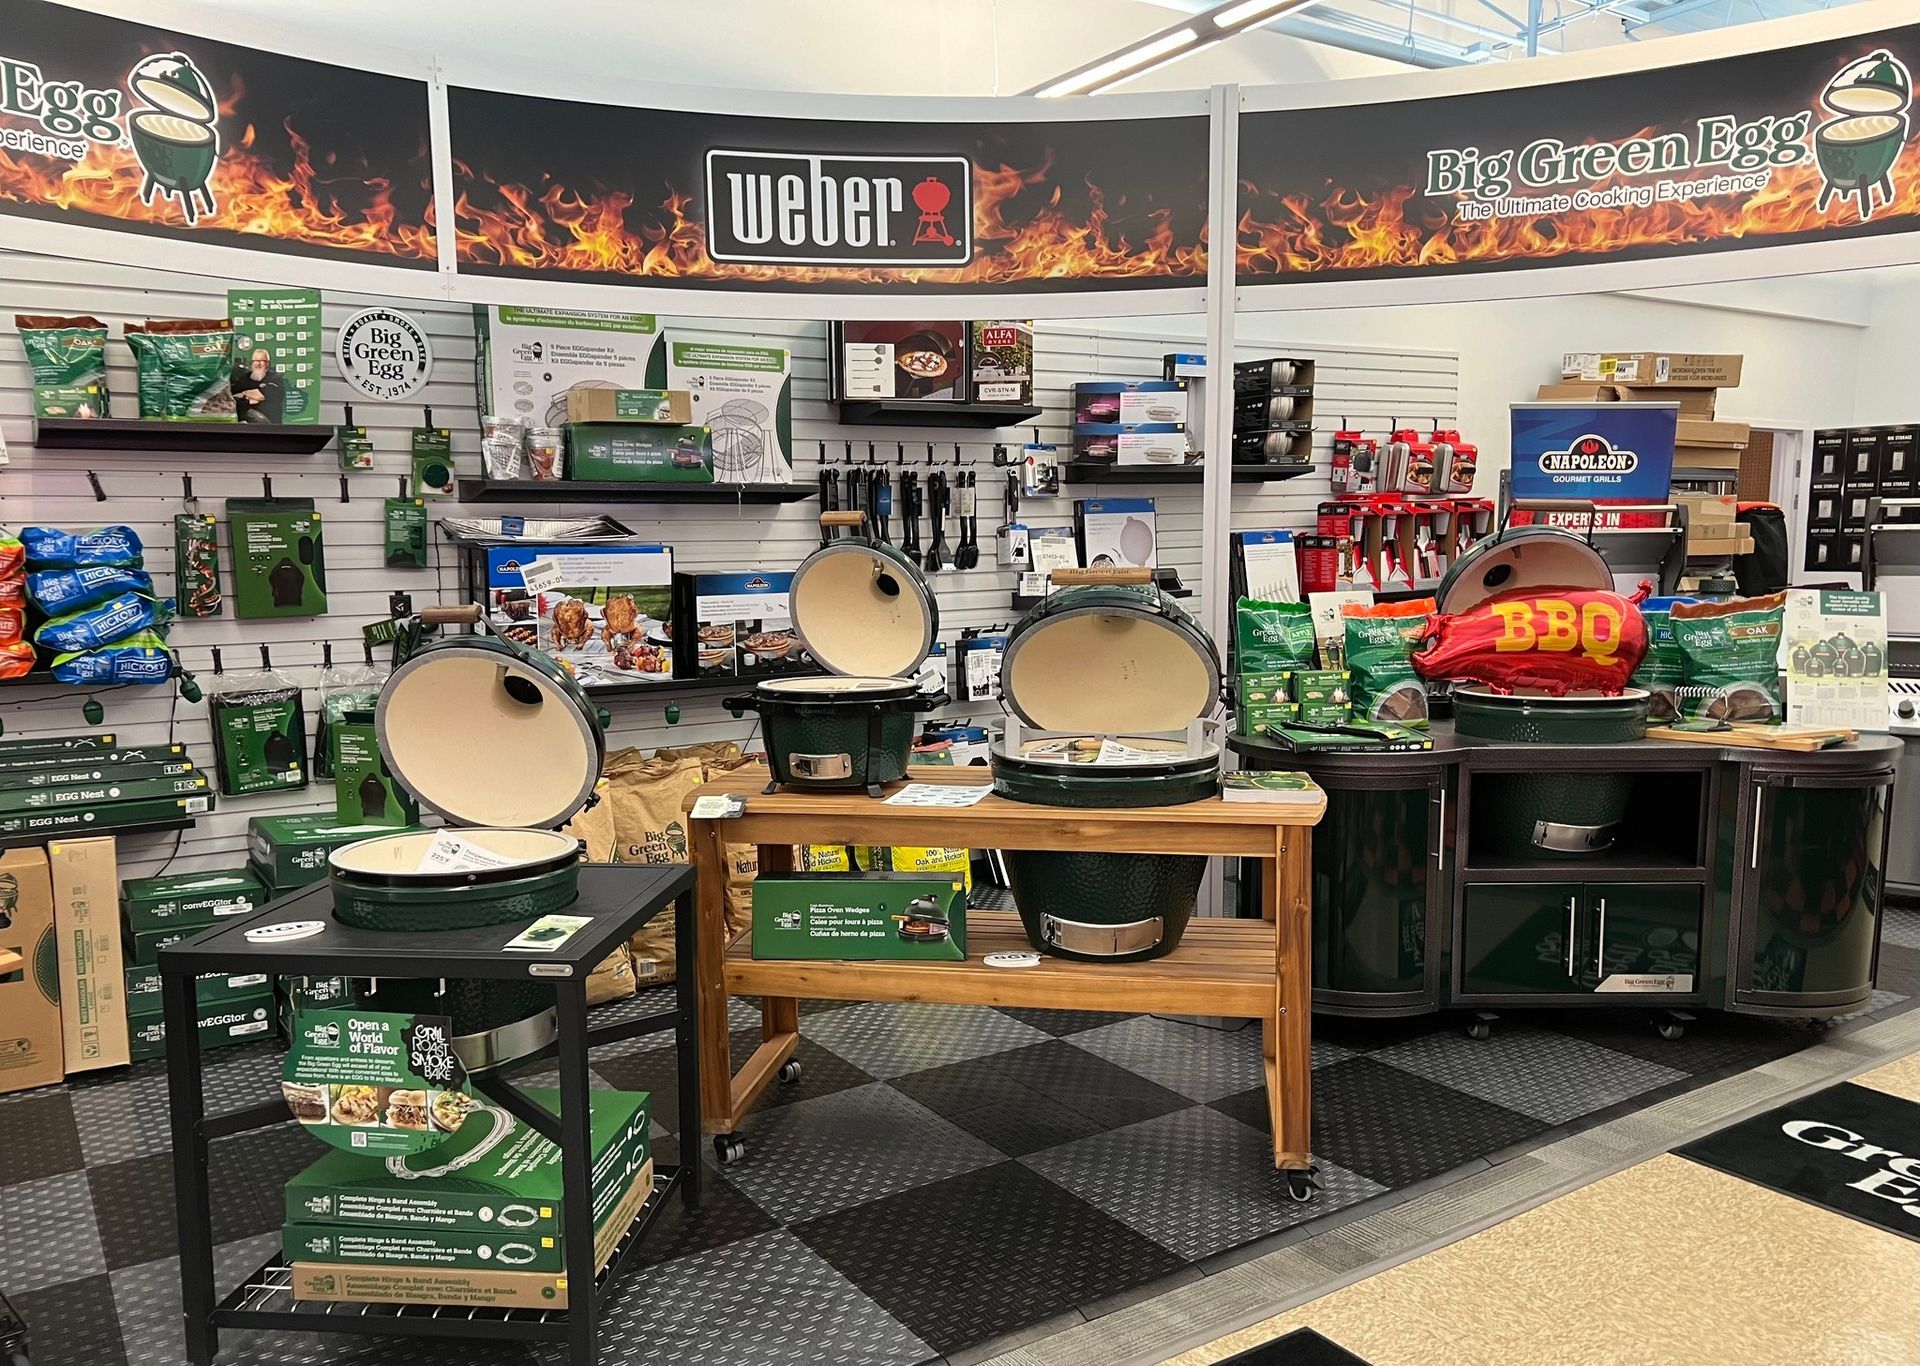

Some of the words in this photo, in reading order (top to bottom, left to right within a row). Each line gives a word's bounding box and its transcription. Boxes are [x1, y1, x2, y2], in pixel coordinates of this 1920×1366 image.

[1, 57, 122, 143] Egg
[1424, 148, 1511, 199] Big
[1517, 131, 1689, 189] Green
[1695, 111, 1811, 173] Egg
[726, 156, 903, 247] weber
[1457, 201, 1493, 221] The
[1496, 193, 1569, 218] Ultimate
[1575, 187, 1651, 211] Cooking
[1658, 174, 1765, 206] Experience
[354, 314, 379, 329] ROAST
[389, 314, 416, 335] SMOKE
[370, 328, 402, 348] Big
[986, 330, 1013, 339] ALFA
[204, 344, 224, 353] OAK
[354, 343, 414, 362] Green
[418, 341, 427, 363] BAKE
[572, 345, 606, 353] EGGspander
[368, 360, 404, 380] Egg
[361, 380, 386, 396] EST.
[388, 384, 411, 397] 1974
[1549, 454, 1628, 470] NAPOLEON
[1548, 512, 1603, 527] EXPERTS
[1606, 512, 1621, 526] IN
[81, 535, 126, 547] HICKORY
[530, 576, 564, 592] 43659-05
[97, 605, 138, 632] HICKORY
[1291, 629, 1312, 638] APPLE
[1490, 600, 1622, 666] BBQ
[1684, 633, 1712, 641] Green
[1694, 630, 1709, 638] Big
[1746, 626, 1768, 635] OAK
[1262, 635, 1279, 644] Egg
[1369, 636, 1385, 644] Egg
[1695, 638, 1713, 648] Egg
[120, 662, 166, 672] HICKORY
[51, 774, 70, 782] EGG
[56, 792, 79, 802] EGG
[80, 790, 105, 800] Nest
[29, 818, 53, 827] EGG
[54, 815, 80, 825] Nest
[645, 831, 666, 842] Big
[629, 842, 667, 856] Green
[818, 849, 840, 859] Natural
[646, 852, 670, 864] Egg
[818, 856, 842, 866] Hickory
[915, 858, 929, 867] Oak
[944, 852, 966, 864] Hickory
[736, 860, 759, 874] Natur
[182, 899, 232, 911] convEGGtor
[316, 981, 328, 990] Big
[314, 1024, 326, 1032] Big
[348, 1019, 379, 1034] Open
[382, 1022, 390, 1031] a
[304, 1030, 328, 1038] Green
[348, 1032, 384, 1044] World
[414, 1024, 446, 1044] GRILL
[314, 1036, 328, 1046] Egg
[412, 1036, 449, 1058] ROAST
[349, 1043, 362, 1054] of
[363, 1044, 400, 1056] Flavor
[308, 1060, 316, 1068] Big
[411, 1051, 454, 1069] SMOKE
[424, 1066, 452, 1081] BAKE
[340, 1195, 366, 1204] Complete
[368, 1196, 386, 1206] Hinge
[393, 1198, 408, 1206] Band
[409, 1199, 438, 1208] Assembly
[340, 1203, 375, 1212] Assemblage
[376, 1204, 400, 1214] Complet
[416, 1206, 446, 1216] Charnière
[454, 1210, 474, 1218] Bande
[346, 1274, 379, 1284] Complete
[381, 1276, 404, 1287] Hinge
[413, 1278, 432, 1286] Band
[434, 1278, 471, 1289] Assembly
[346, 1282, 390, 1292] Assemblage
[392, 1284, 424, 1295] Complet
[446, 1286, 482, 1295] Charnière
[493, 1288, 518, 1296] Bande
